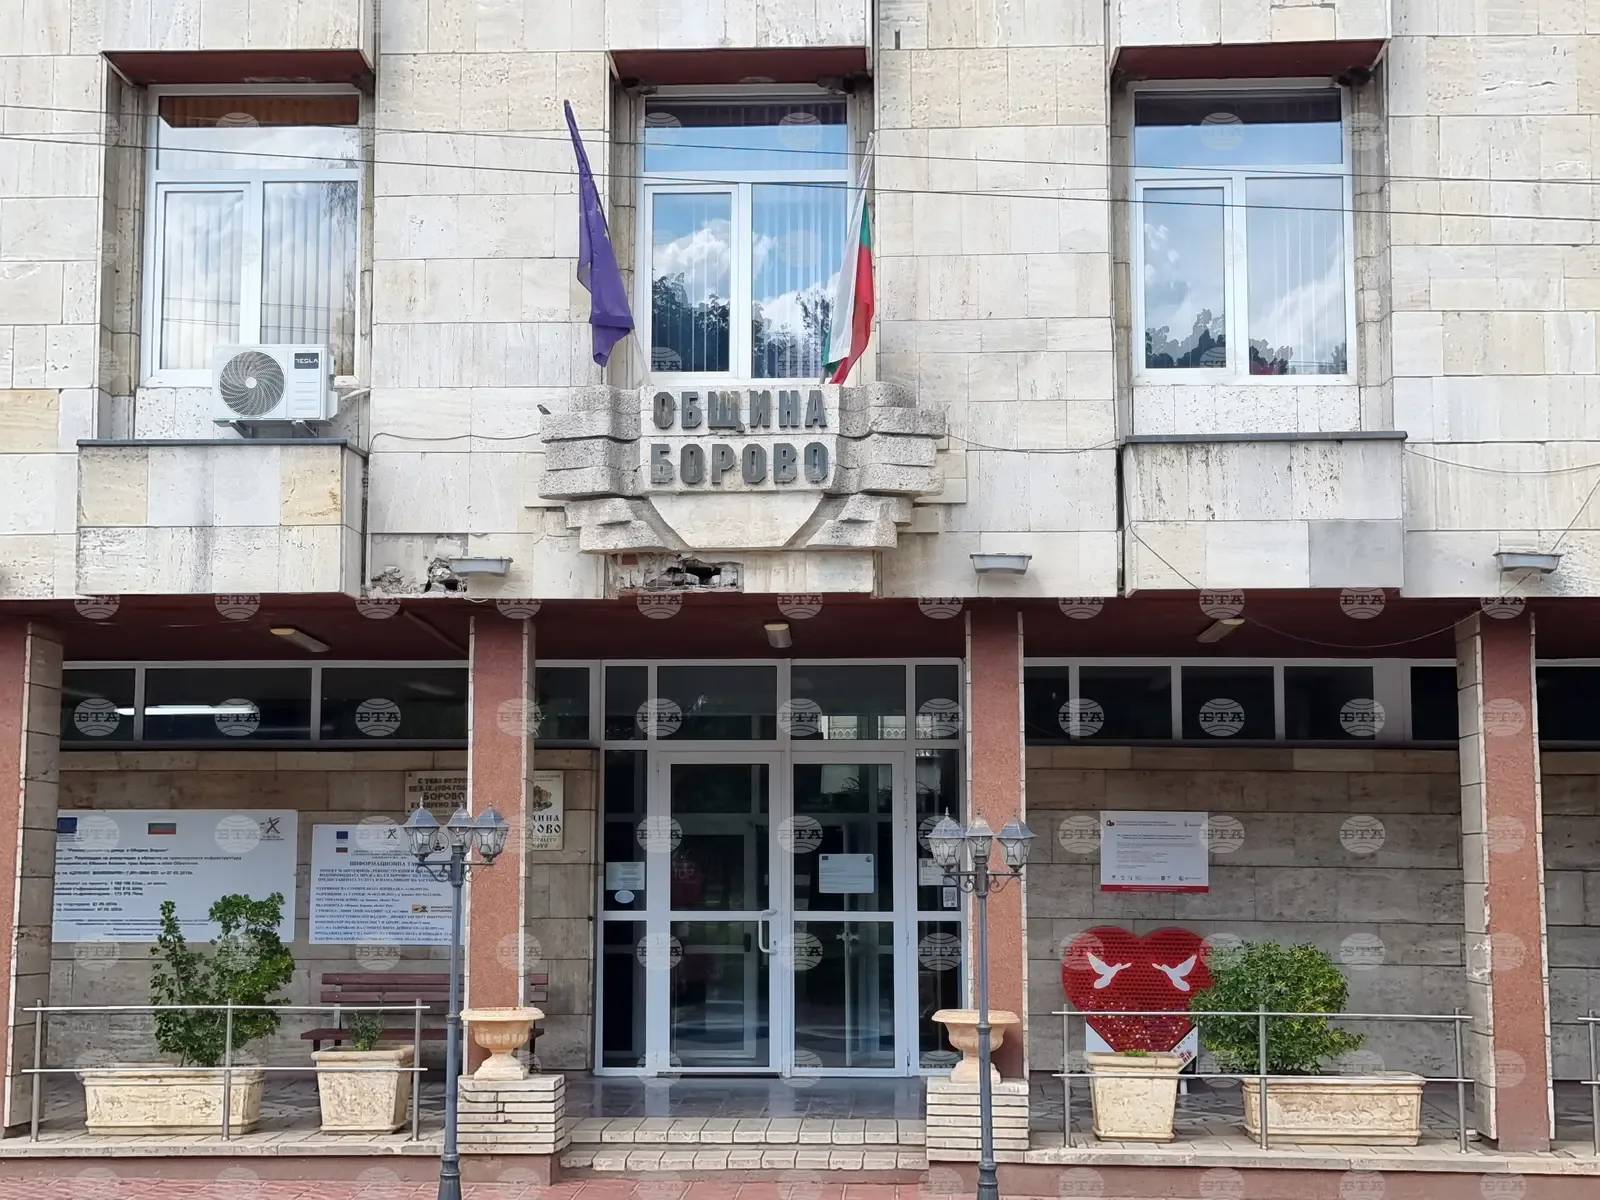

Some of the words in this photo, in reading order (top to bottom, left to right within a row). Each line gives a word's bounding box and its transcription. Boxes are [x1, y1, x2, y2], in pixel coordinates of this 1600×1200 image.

[652, 389, 828, 433] ОБЩИНА
[650, 441, 829, 484] БОРОВО
[423, 792, 465, 801] БОРОВО
